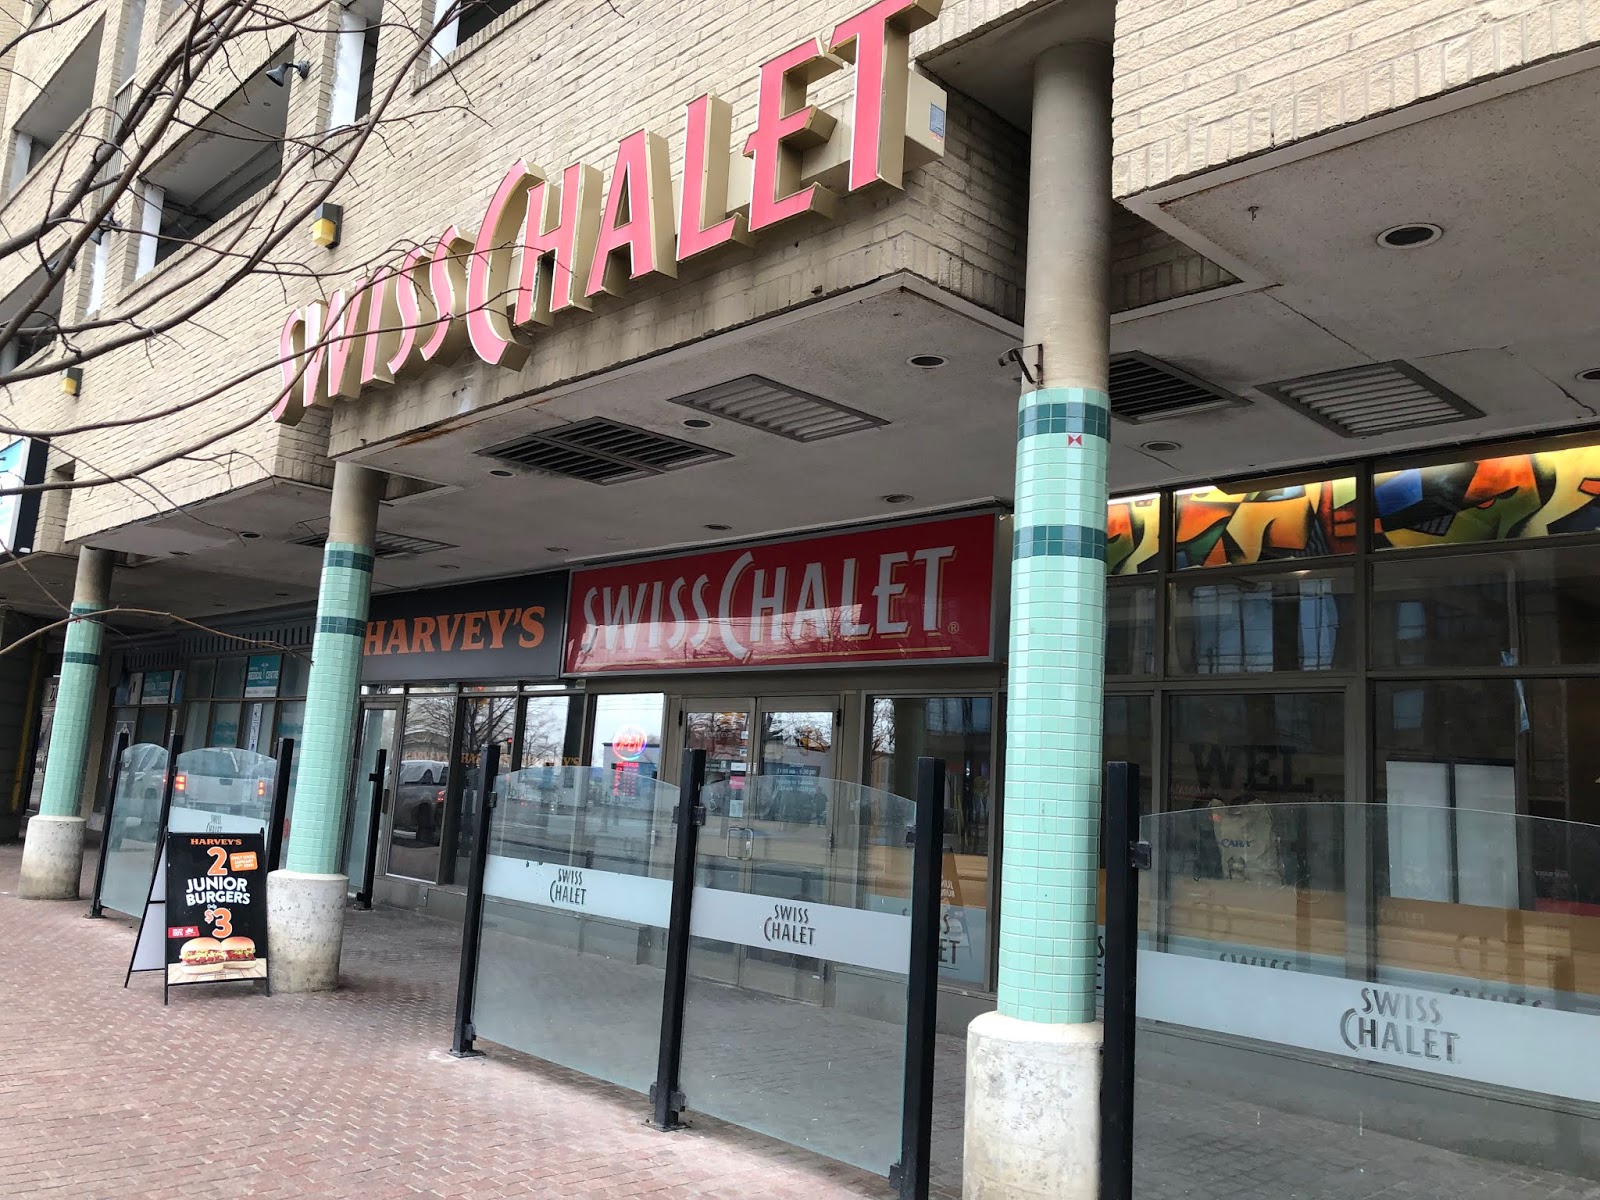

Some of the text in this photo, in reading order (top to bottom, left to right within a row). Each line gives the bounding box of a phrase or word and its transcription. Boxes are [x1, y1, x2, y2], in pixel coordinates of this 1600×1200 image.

[271, 0, 940, 426] SWISS CHALET
[581, 545, 956, 660] SWISS CHALET
[363, 605, 546, 656] HARVEY'S
[190, 838, 242, 846] HARVEY'S
[207, 846, 228, 876] 2
[186, 876, 248, 893] JUNIOR
[558, 868, 583, 885] SWISS
[185, 890, 251, 907] BURGERS
[550, 880, 587, 905] CHALET
[204, 907, 233, 938] $3
[774, 904, 809, 924] SWISS
[764, 916, 816, 946] CHALET
[1361, 987, 1443, 1025] SWISS
[1340, 1007, 1460, 1062] CHALET
